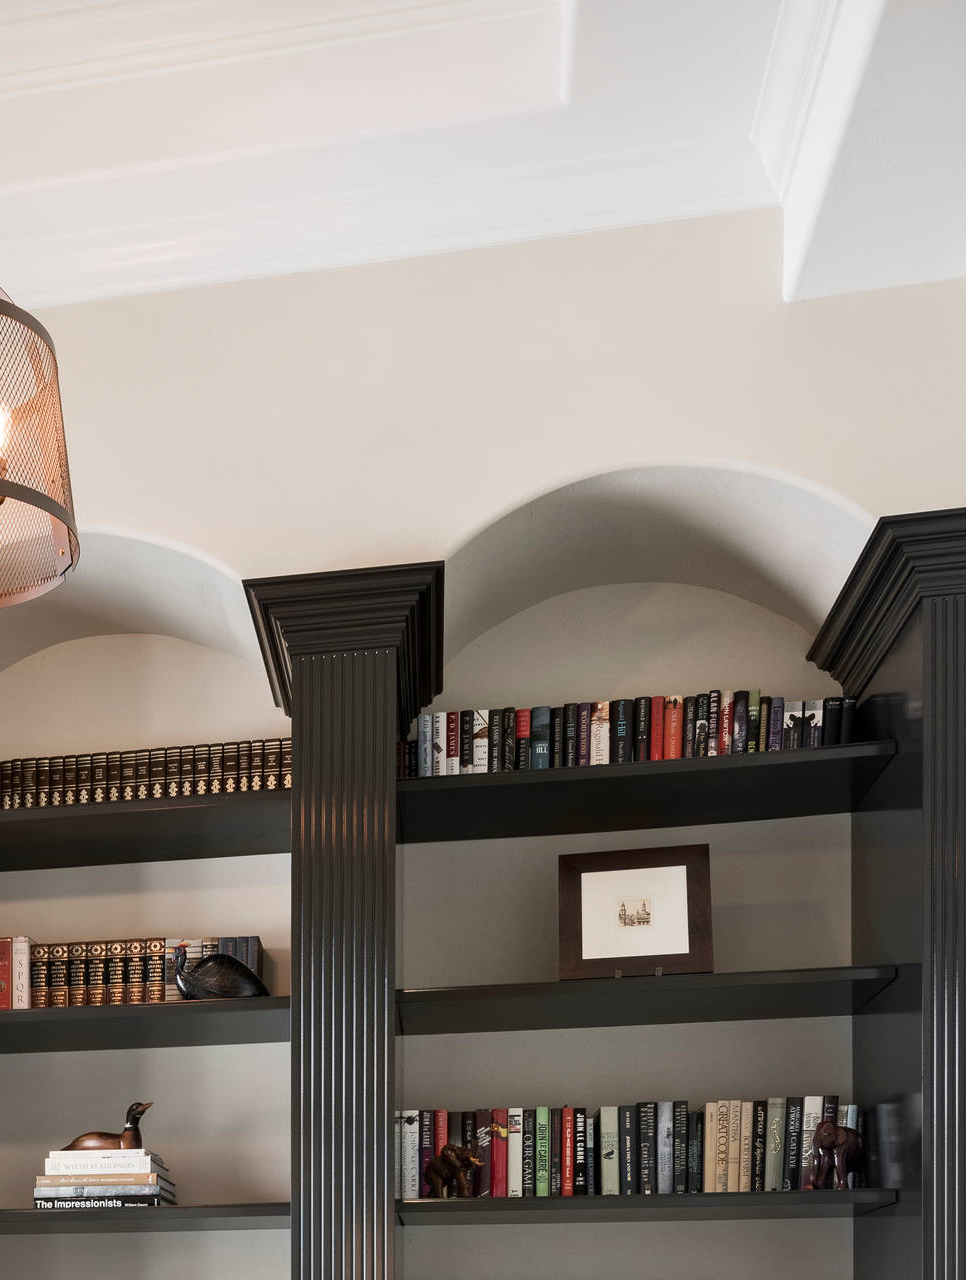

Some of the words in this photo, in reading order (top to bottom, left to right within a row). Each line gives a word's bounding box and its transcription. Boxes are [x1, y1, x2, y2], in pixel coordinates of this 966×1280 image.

[710, 691, 718, 712] ALAN
[618, 721, 626, 737] Hill
[708, 714, 717, 738] FURST
[722, 715, 730, 741] LAWTON
[448, 732, 456, 755] JAMES
[576, 1113, 584, 1131] JOHN
[718, 1104, 729, 1134] GREAT
[730, 1104, 740, 1142] MANTISSA
[789, 1105, 797, 1134] ATWOOD
[538, 1122, 548, 1141] JOHN
[576, 1132, 584, 1141] LE
[523, 1133, 533, 1157] OUR
[717, 1134, 729, 1166] CODE
[522, 1160, 533, 1189] GAME
[35, 1199, 53, 1209] The
[54, 1198, 122, 1209] Impressionists
